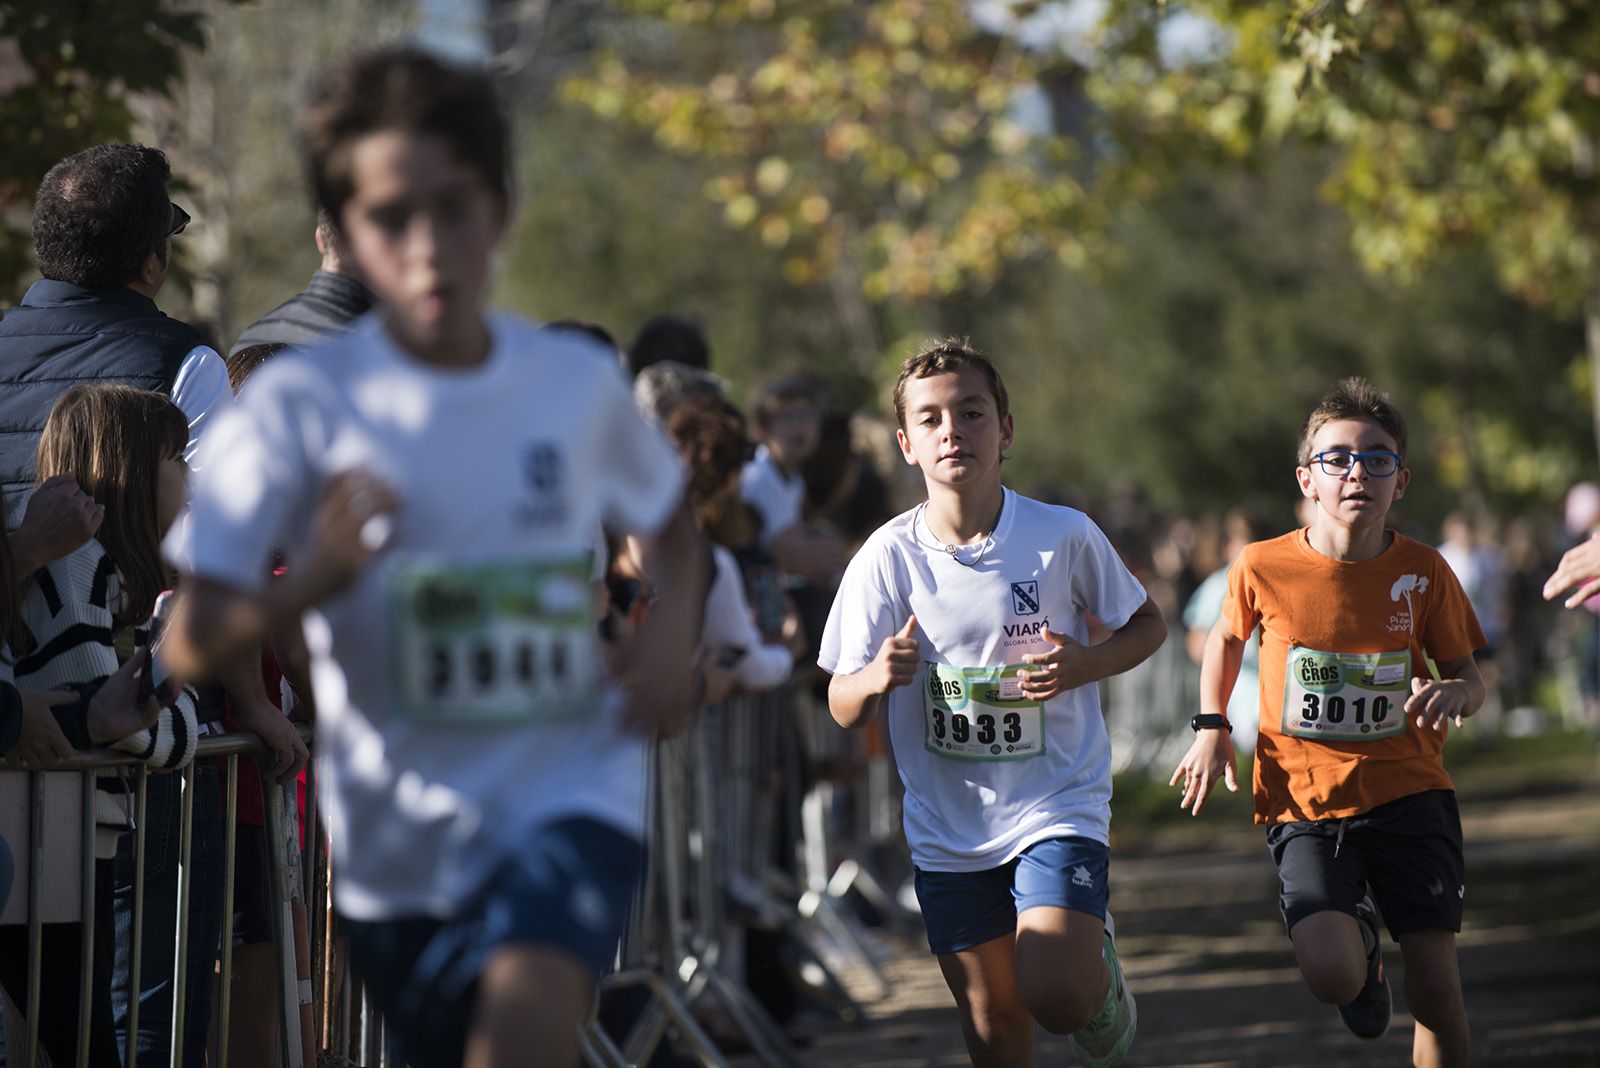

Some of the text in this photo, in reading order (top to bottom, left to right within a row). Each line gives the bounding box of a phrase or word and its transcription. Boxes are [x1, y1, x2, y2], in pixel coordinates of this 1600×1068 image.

[1004, 639, 1028, 648] GLOBAL
[1301, 666, 1339, 681] CROS
[931, 680, 961, 696] CROS
[1301, 693, 1389, 724] 3010
[932, 708, 1022, 745] 3933
